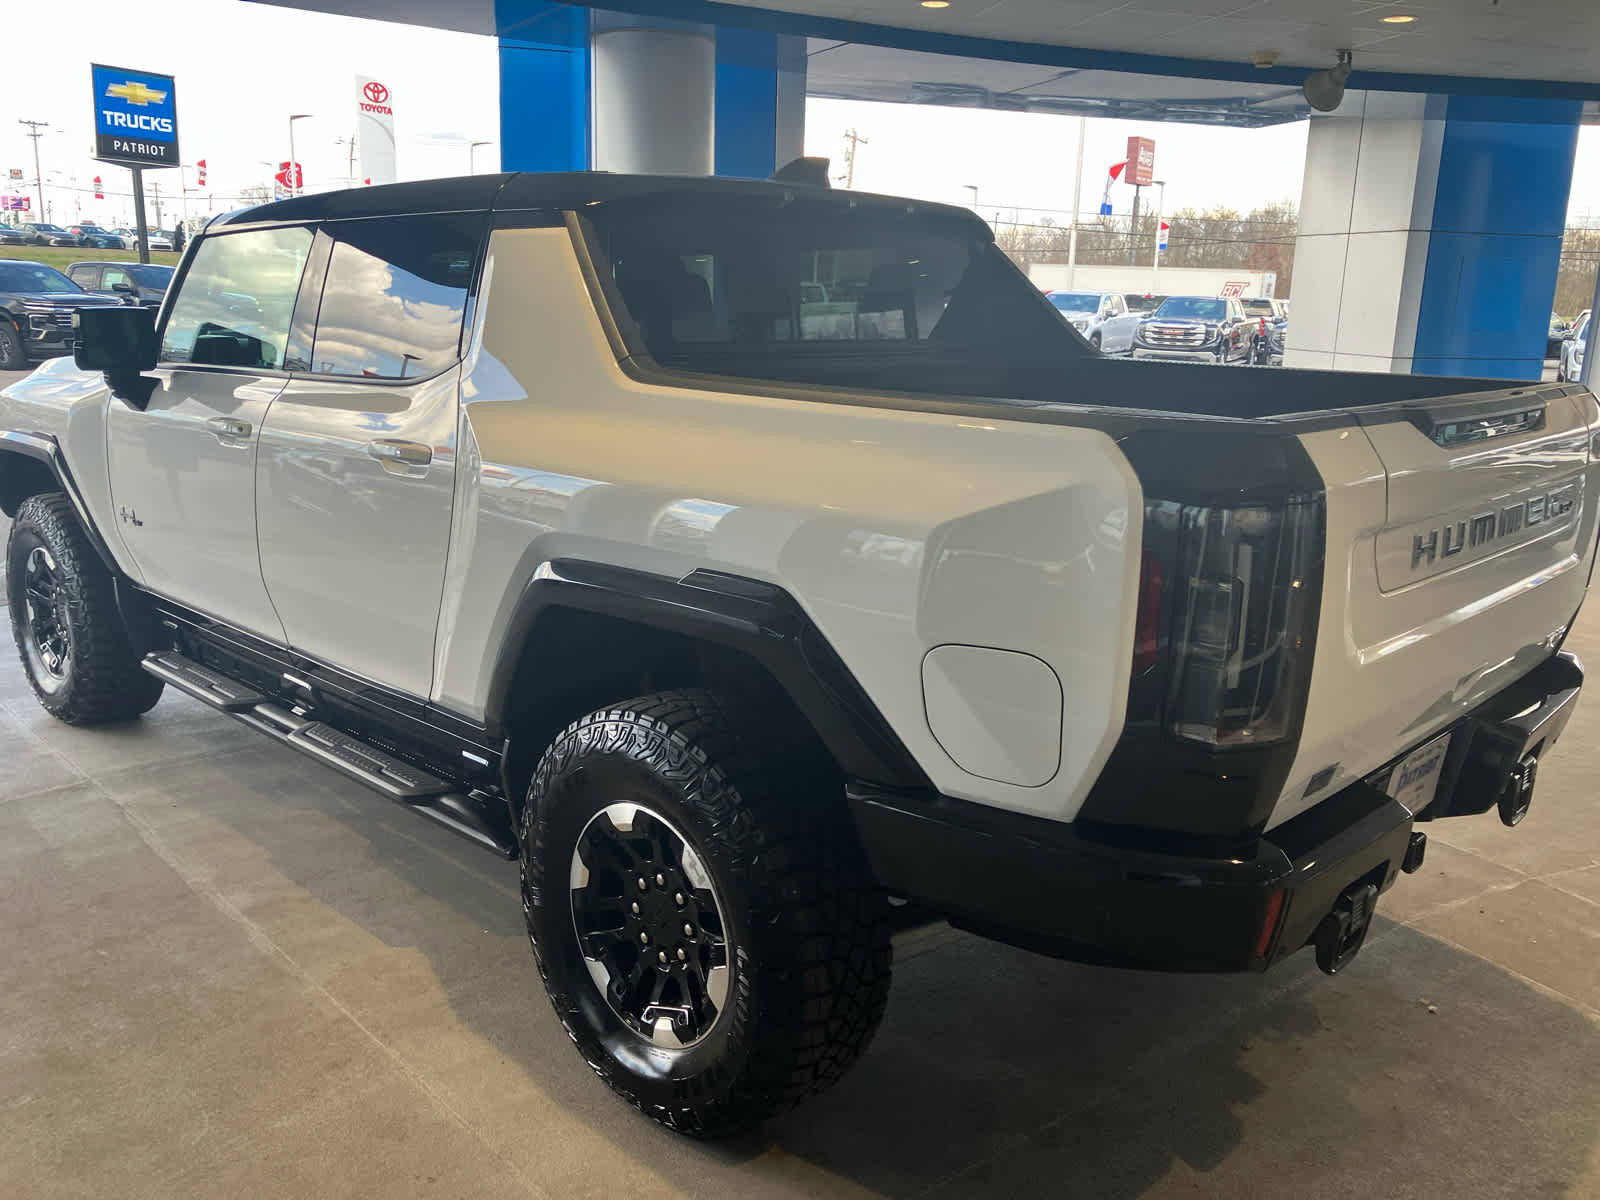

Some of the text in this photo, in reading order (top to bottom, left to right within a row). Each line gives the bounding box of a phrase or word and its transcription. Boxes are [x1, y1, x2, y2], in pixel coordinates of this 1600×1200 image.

[360, 102, 392, 115] TOYOTA
[102, 109, 173, 133] TRUCKS
[113, 140, 165, 156] PATRIOT
